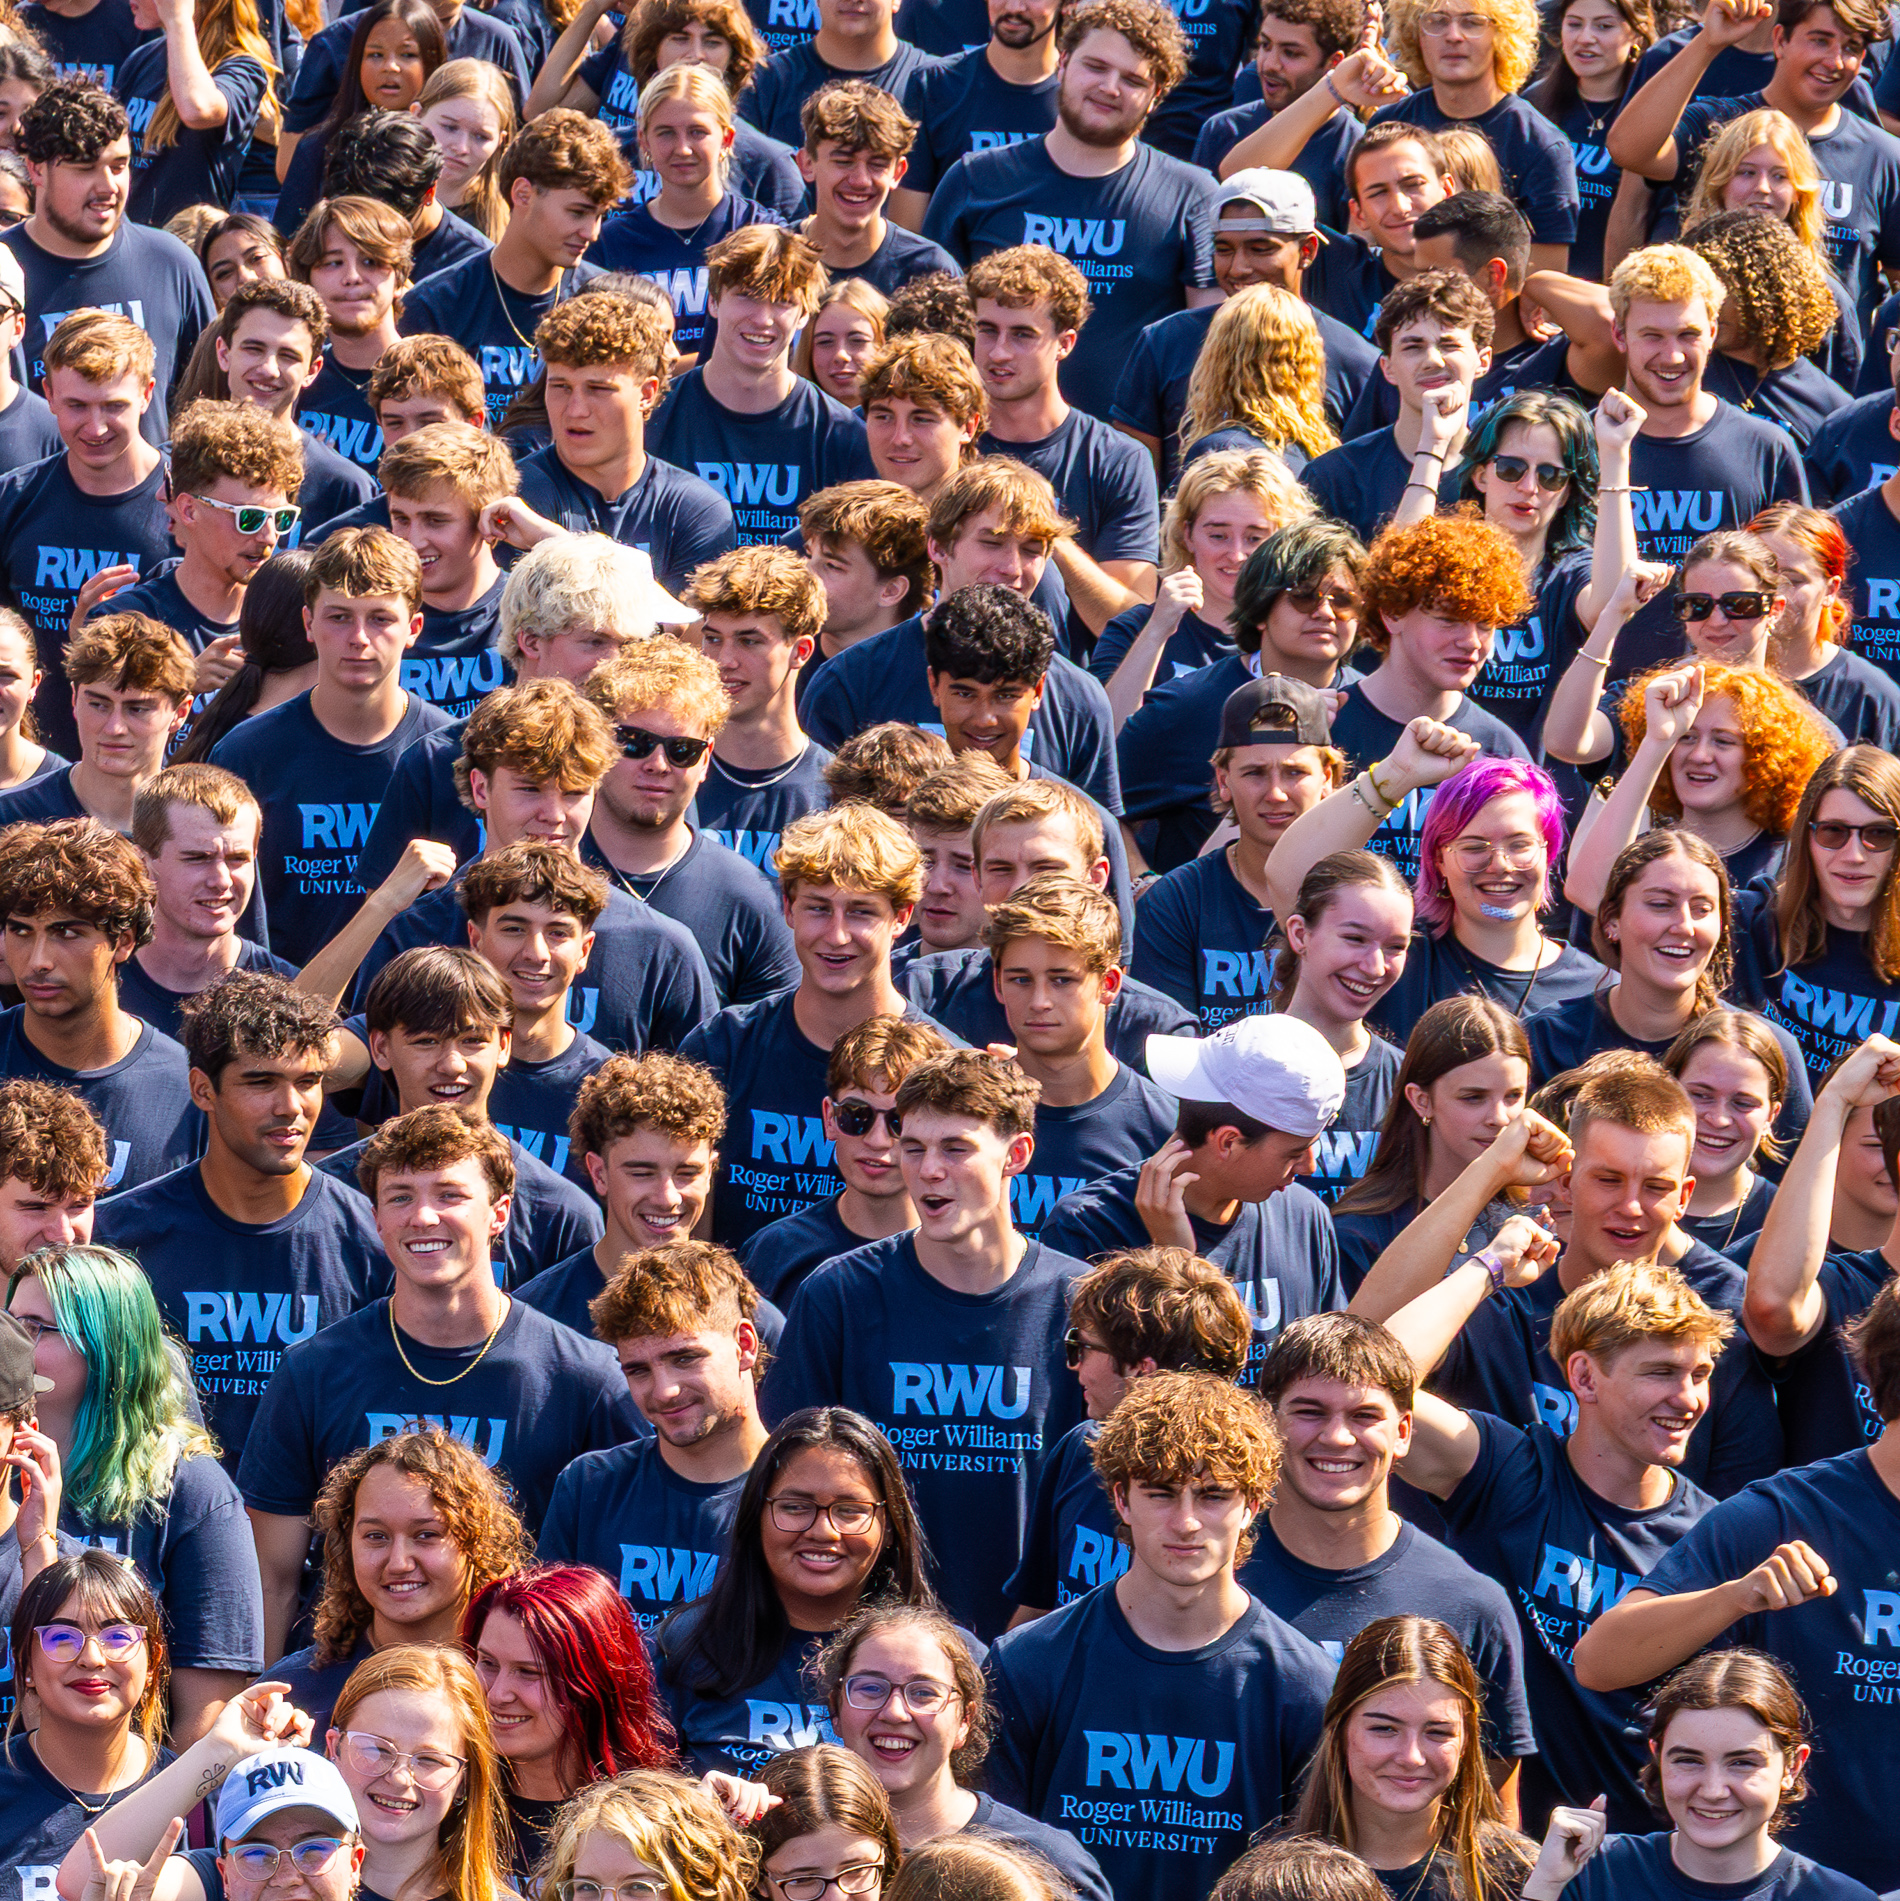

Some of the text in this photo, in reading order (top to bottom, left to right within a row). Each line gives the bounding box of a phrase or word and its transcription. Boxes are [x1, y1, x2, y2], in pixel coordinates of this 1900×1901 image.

[770, 0, 821, 29] RW
[608, 71, 640, 112] RW
[1023, 212, 1125, 255] RWU
[483, 345, 545, 384] RW
[735, 510, 799, 526] William
[21, 591, 70, 611] Roger
[1491, 616, 1545, 662] WU
[399, 649, 503, 701] RWU
[1473, 682, 1545, 700] VERSITY
[298, 804, 380, 848] RW
[285, 856, 339, 875] Roger
[1203, 949, 1281, 996] RW
[1201, 1005, 1236, 1026] oger
[1782, 970, 1900, 1040] RWU
[751, 1109, 839, 1166] RW
[729, 1165, 846, 1197] Roger Willia
[185, 1292, 319, 1345] RWU
[234, 1351, 281, 1373] Willi
[889, 1363, 1032, 1419] RWU
[936, 1425, 1043, 1451] Williams
[895, 1450, 1024, 1474] UNIVERSITY
[1070, 1524, 1131, 1587] RW
[1535, 1544, 1641, 1614] RW
[746, 1699, 833, 1749] RW
[1084, 1730, 1235, 1797] RWU
[1060, 1795, 1243, 1831] Roger Williams
[1080, 1826, 1220, 1854] UNIVERSITY
